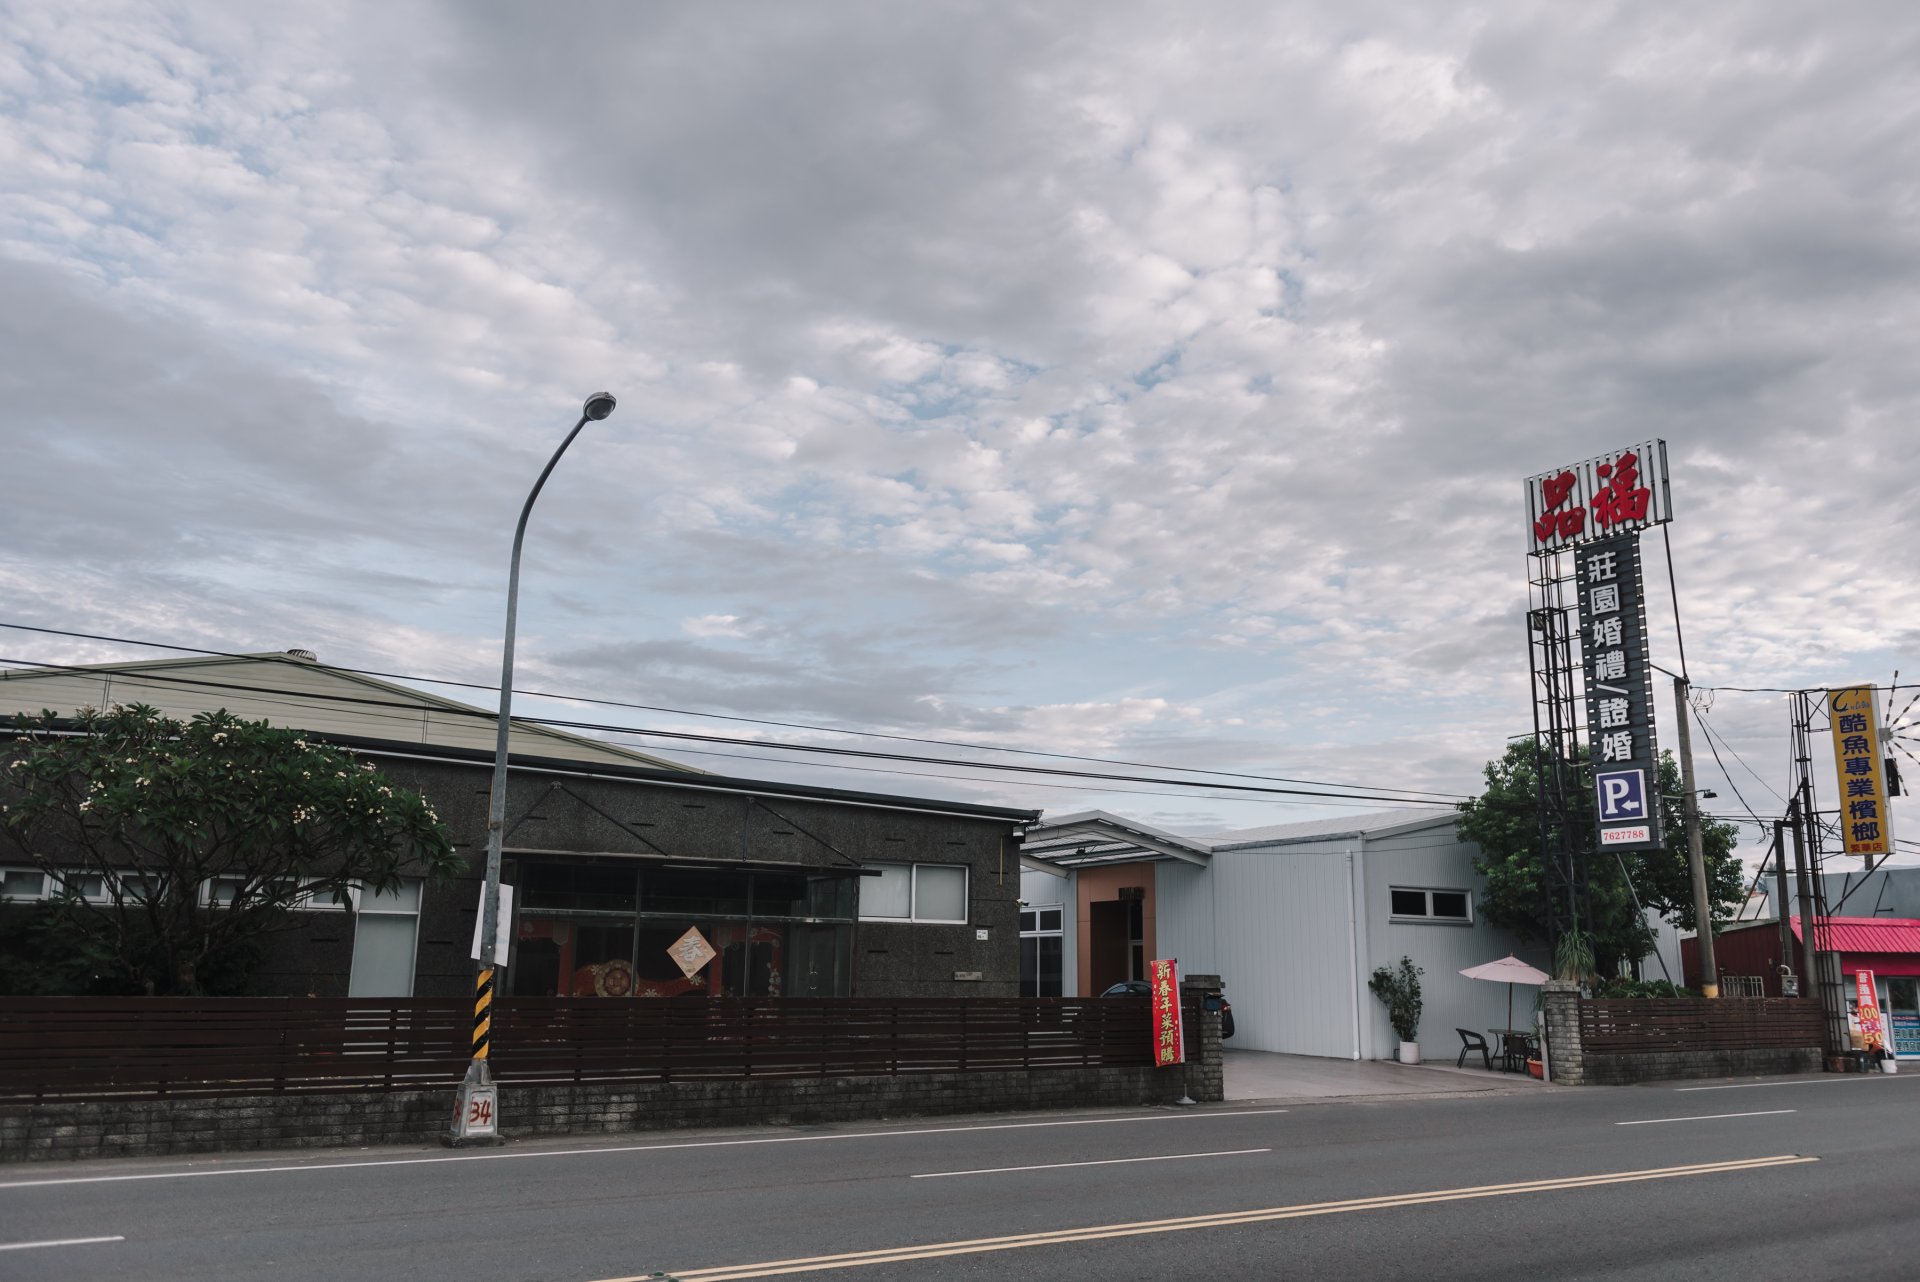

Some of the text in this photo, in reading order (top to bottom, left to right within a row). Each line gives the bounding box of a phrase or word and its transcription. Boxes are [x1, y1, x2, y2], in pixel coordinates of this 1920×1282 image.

[1839, 713, 1880, 841] 酷魚專業檳榔
[1603, 779, 1630, 814] P
[1603, 829, 1646, 842] 7627788
[678, 935, 704, 962] 春
[1157, 962, 1175, 1062] 新春年菜預購
[469, 1100, 491, 1126] 34
